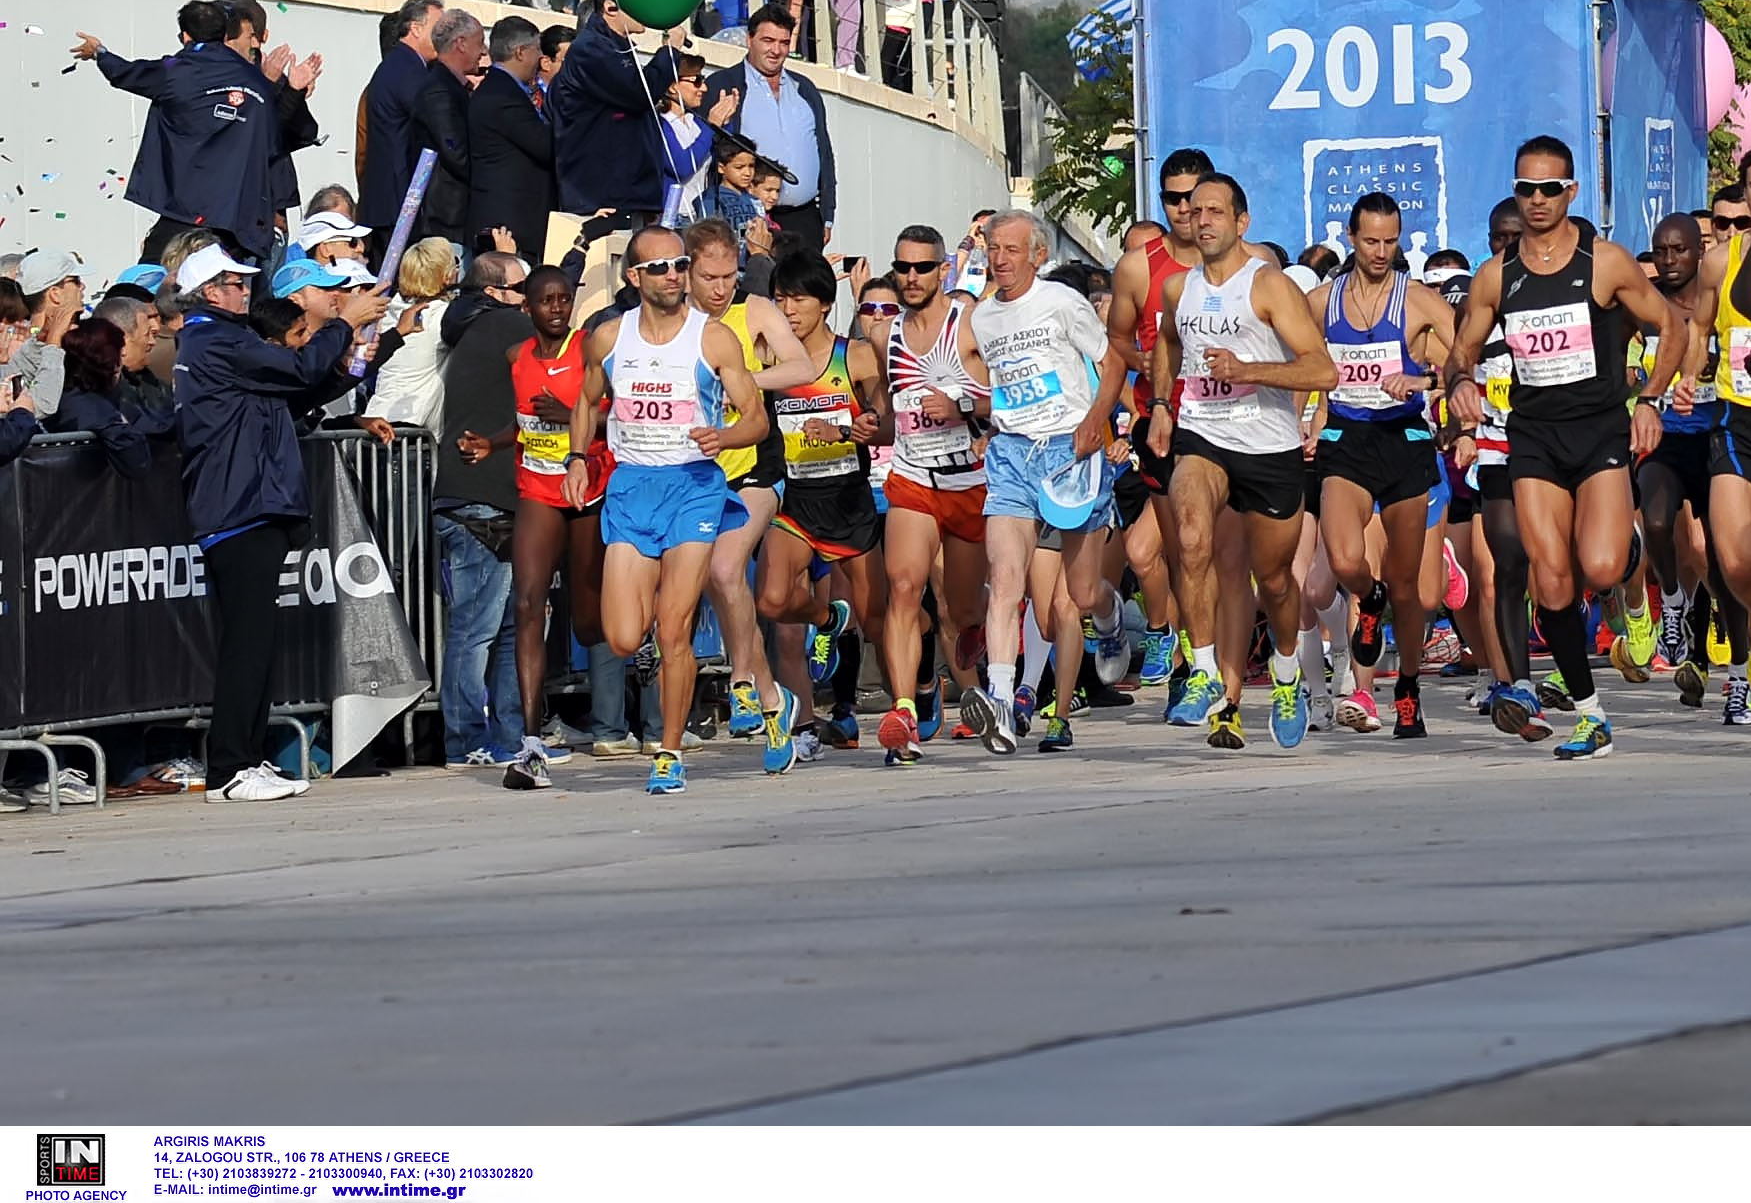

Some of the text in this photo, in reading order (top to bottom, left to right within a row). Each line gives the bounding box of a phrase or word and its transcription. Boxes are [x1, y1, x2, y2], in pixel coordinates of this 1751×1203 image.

[1266, 21, 1473, 111] 2013
[1327, 161, 1423, 177] ATHENS
[1327, 180, 1423, 195] CLASSIC
[1327, 199, 1424, 214] MAON
[1012, 326, 1051, 342] ΑΣΚΙΟΥ
[1179, 315, 1241, 336] HELLAS
[1525, 329, 1571, 355] 202
[1343, 363, 1382, 383] 209
[1003, 377, 1049, 407] 3958
[1199, 377, 1233, 397] 376
[632, 399, 673, 421] 203
[774, 392, 850, 414] KOMORI
[33, 543, 207, 613] POWERADE
